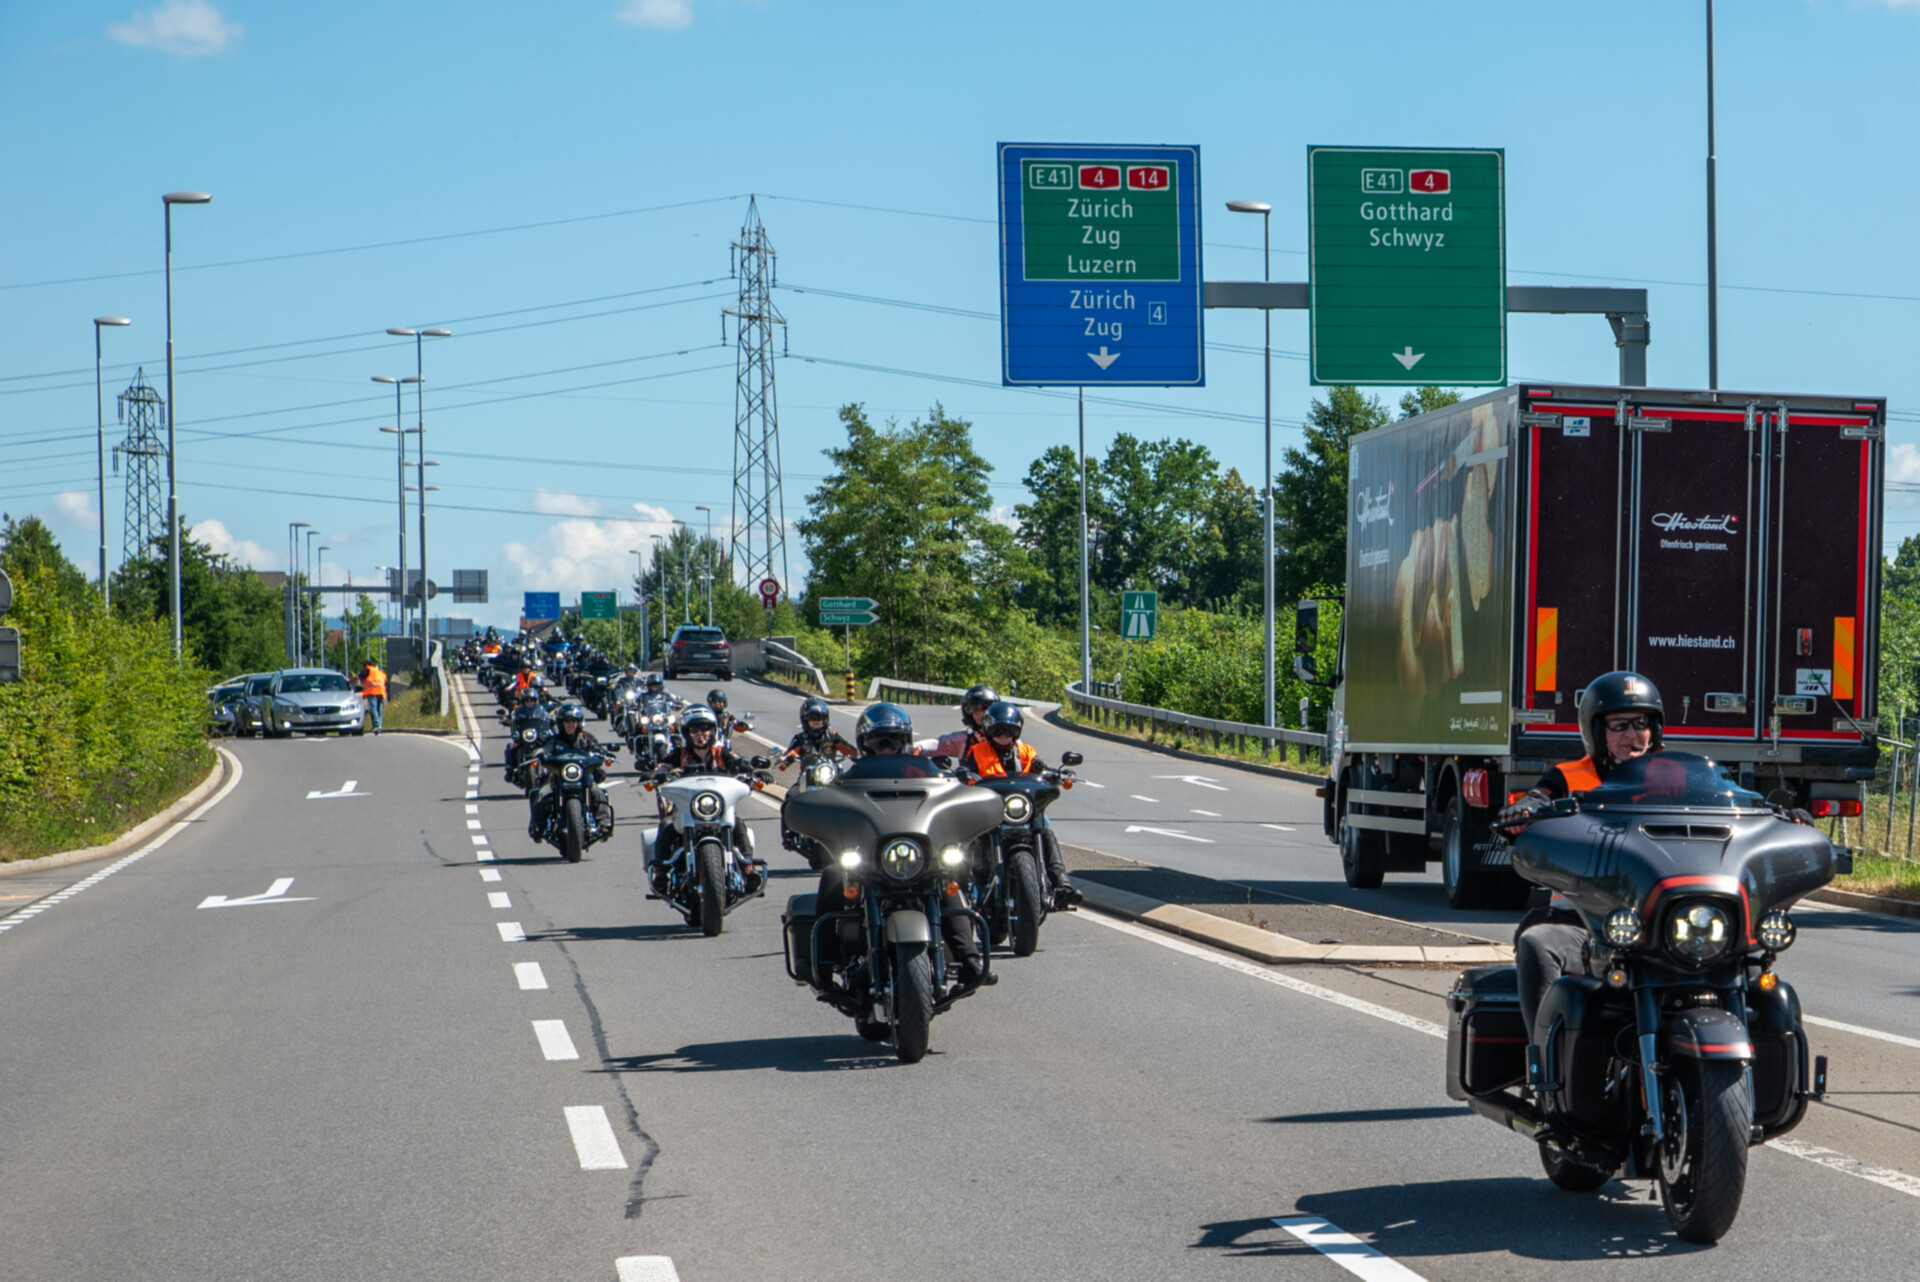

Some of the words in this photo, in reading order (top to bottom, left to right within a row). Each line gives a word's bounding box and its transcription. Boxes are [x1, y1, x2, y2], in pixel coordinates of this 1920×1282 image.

[1094, 170, 1105, 186] 4
[1138, 170, 1159, 187] 14
[1424, 173, 1435, 190] 4
[1067, 198, 1133, 218] Zürich
[1360, 202, 1453, 221] Gotthard
[1082, 225, 1120, 250] Zug
[1369, 227, 1445, 252] Schwyz
[1067, 255, 1136, 274] Luzern
[1070, 290, 1135, 310] Zürich
[1152, 306, 1163, 321] 4
[1084, 317, 1123, 342] Zug
[1651, 512, 1738, 535] Hiestand
[822, 599, 857, 609] Gotthard
[823, 614, 851, 623] Schwyz
[1648, 633, 1736, 649] www.hiestand.ch
